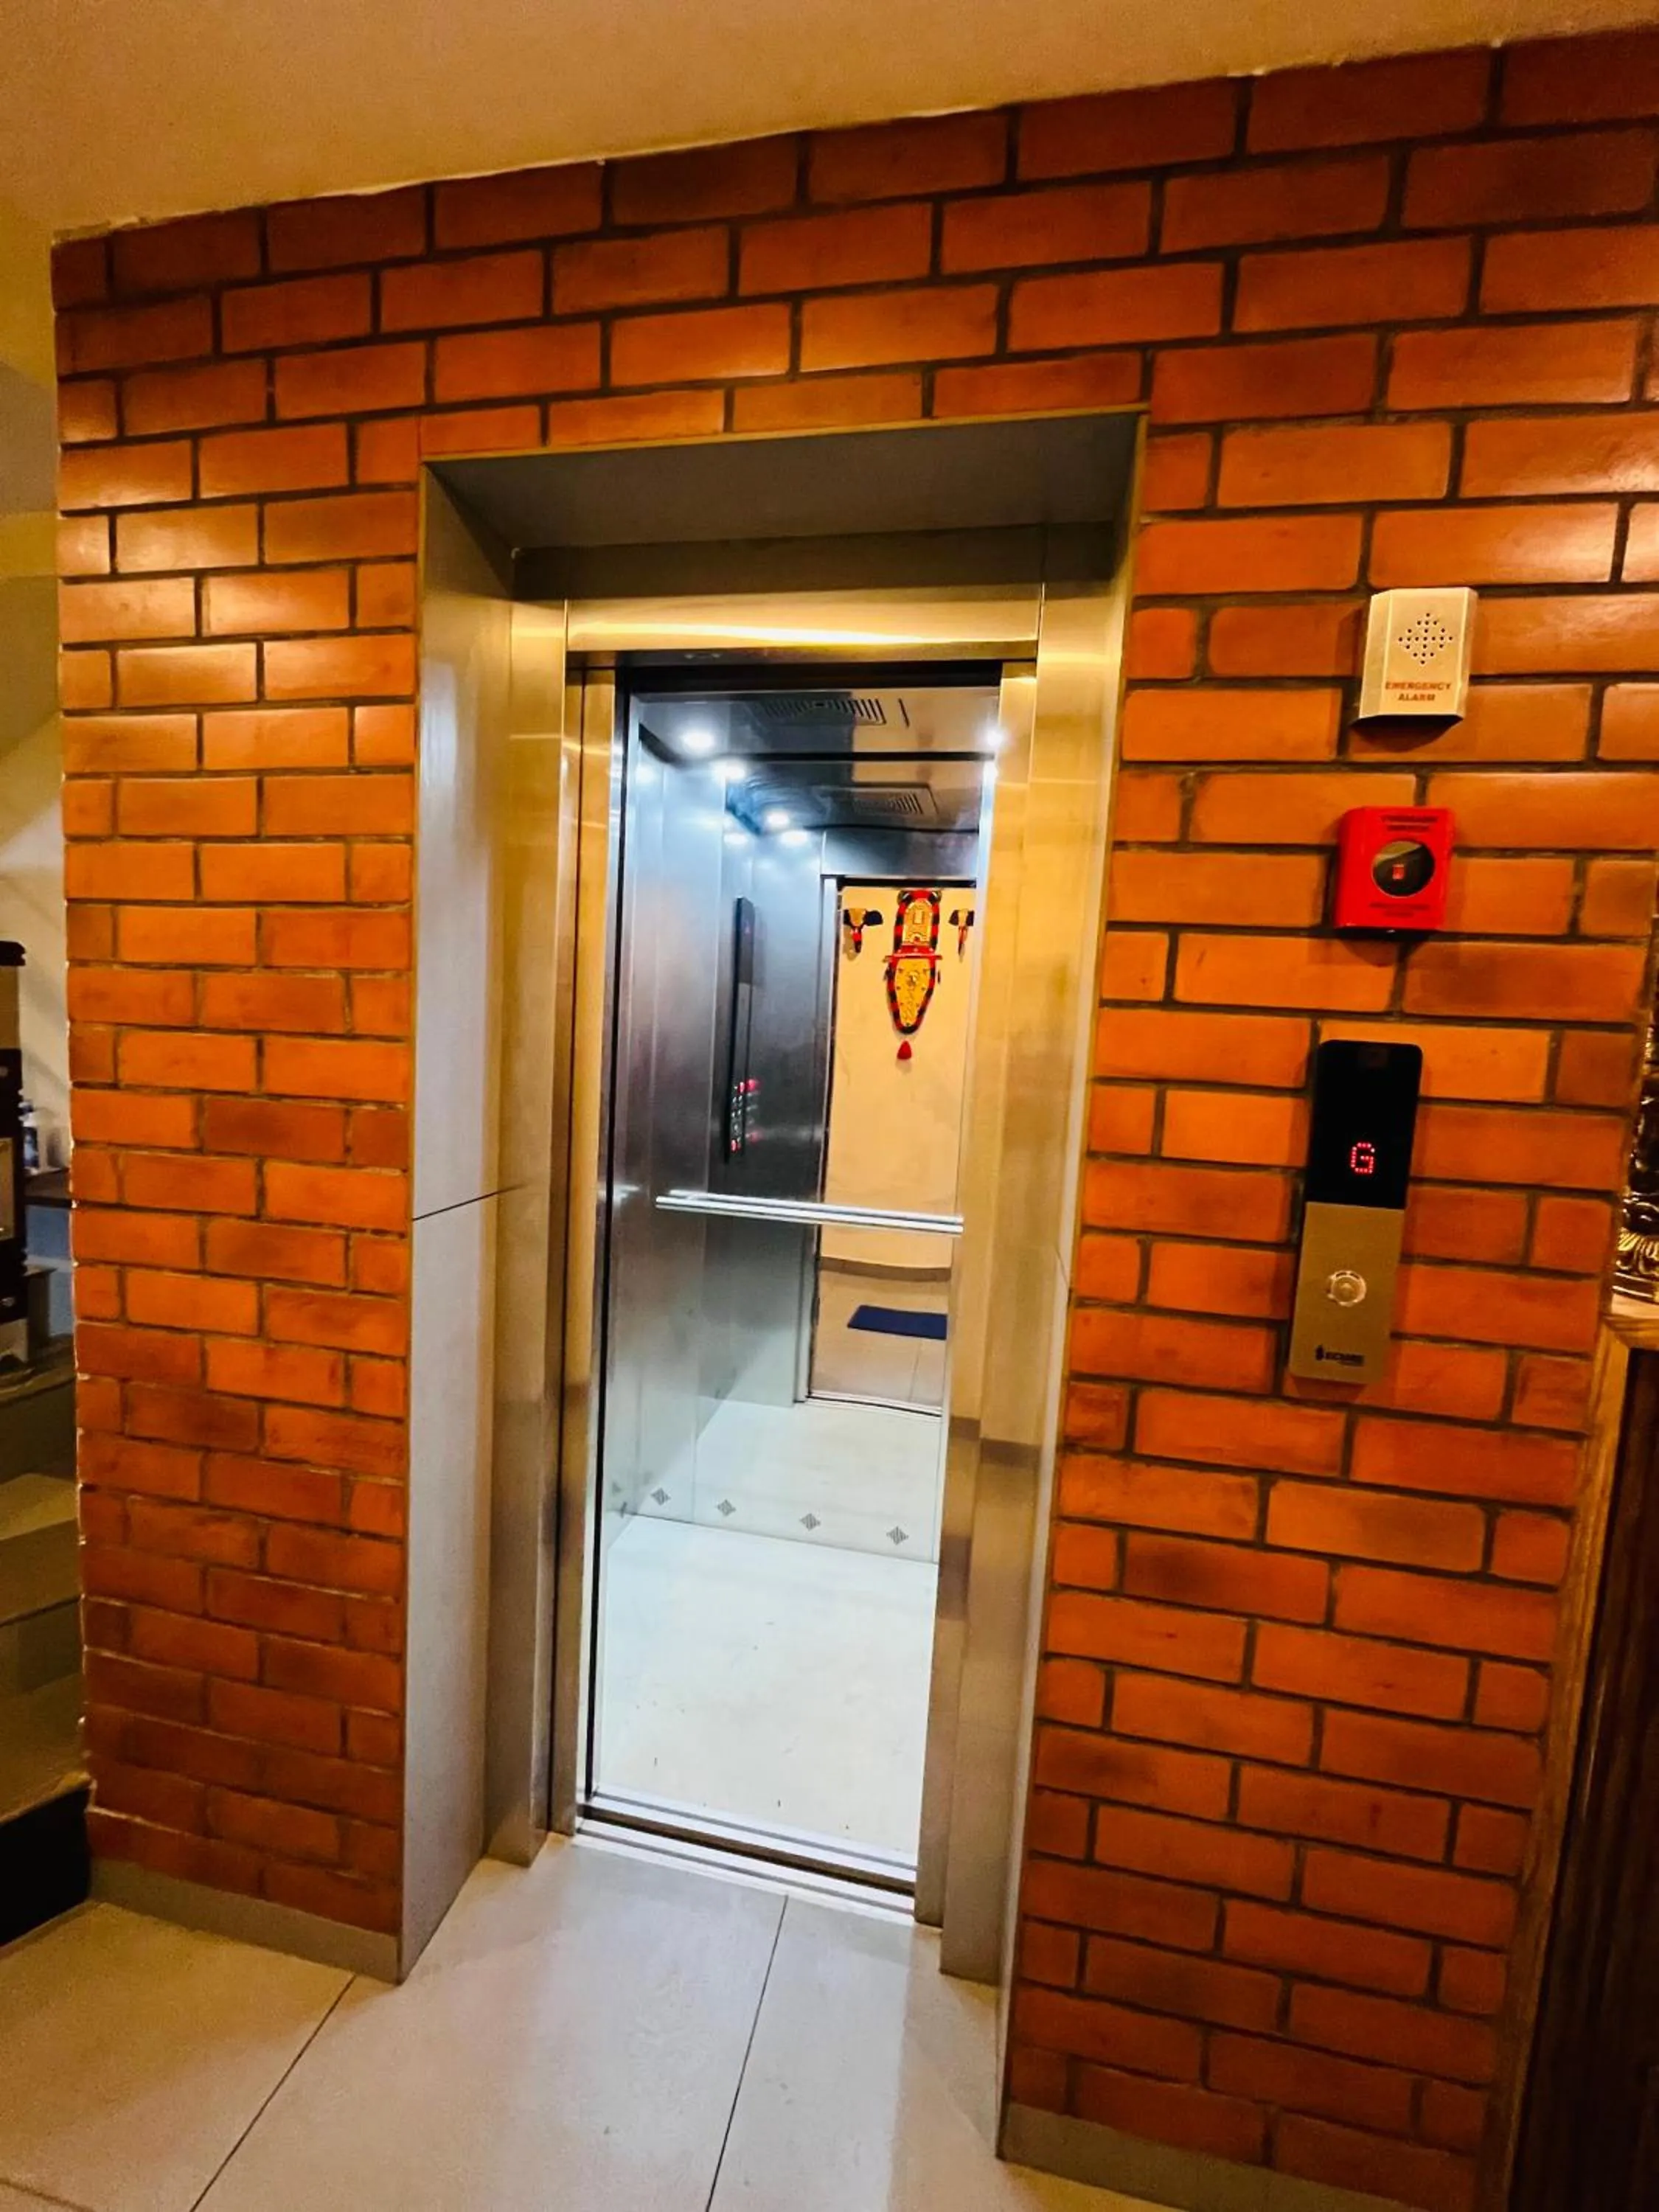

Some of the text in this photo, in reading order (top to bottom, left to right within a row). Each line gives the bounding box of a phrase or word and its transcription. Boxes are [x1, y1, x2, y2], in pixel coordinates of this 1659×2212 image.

[1385, 681, 1451, 691] EMERGENCY
[1397, 693, 1436, 701] ALARM
[1350, 1142, 1375, 1174] G
